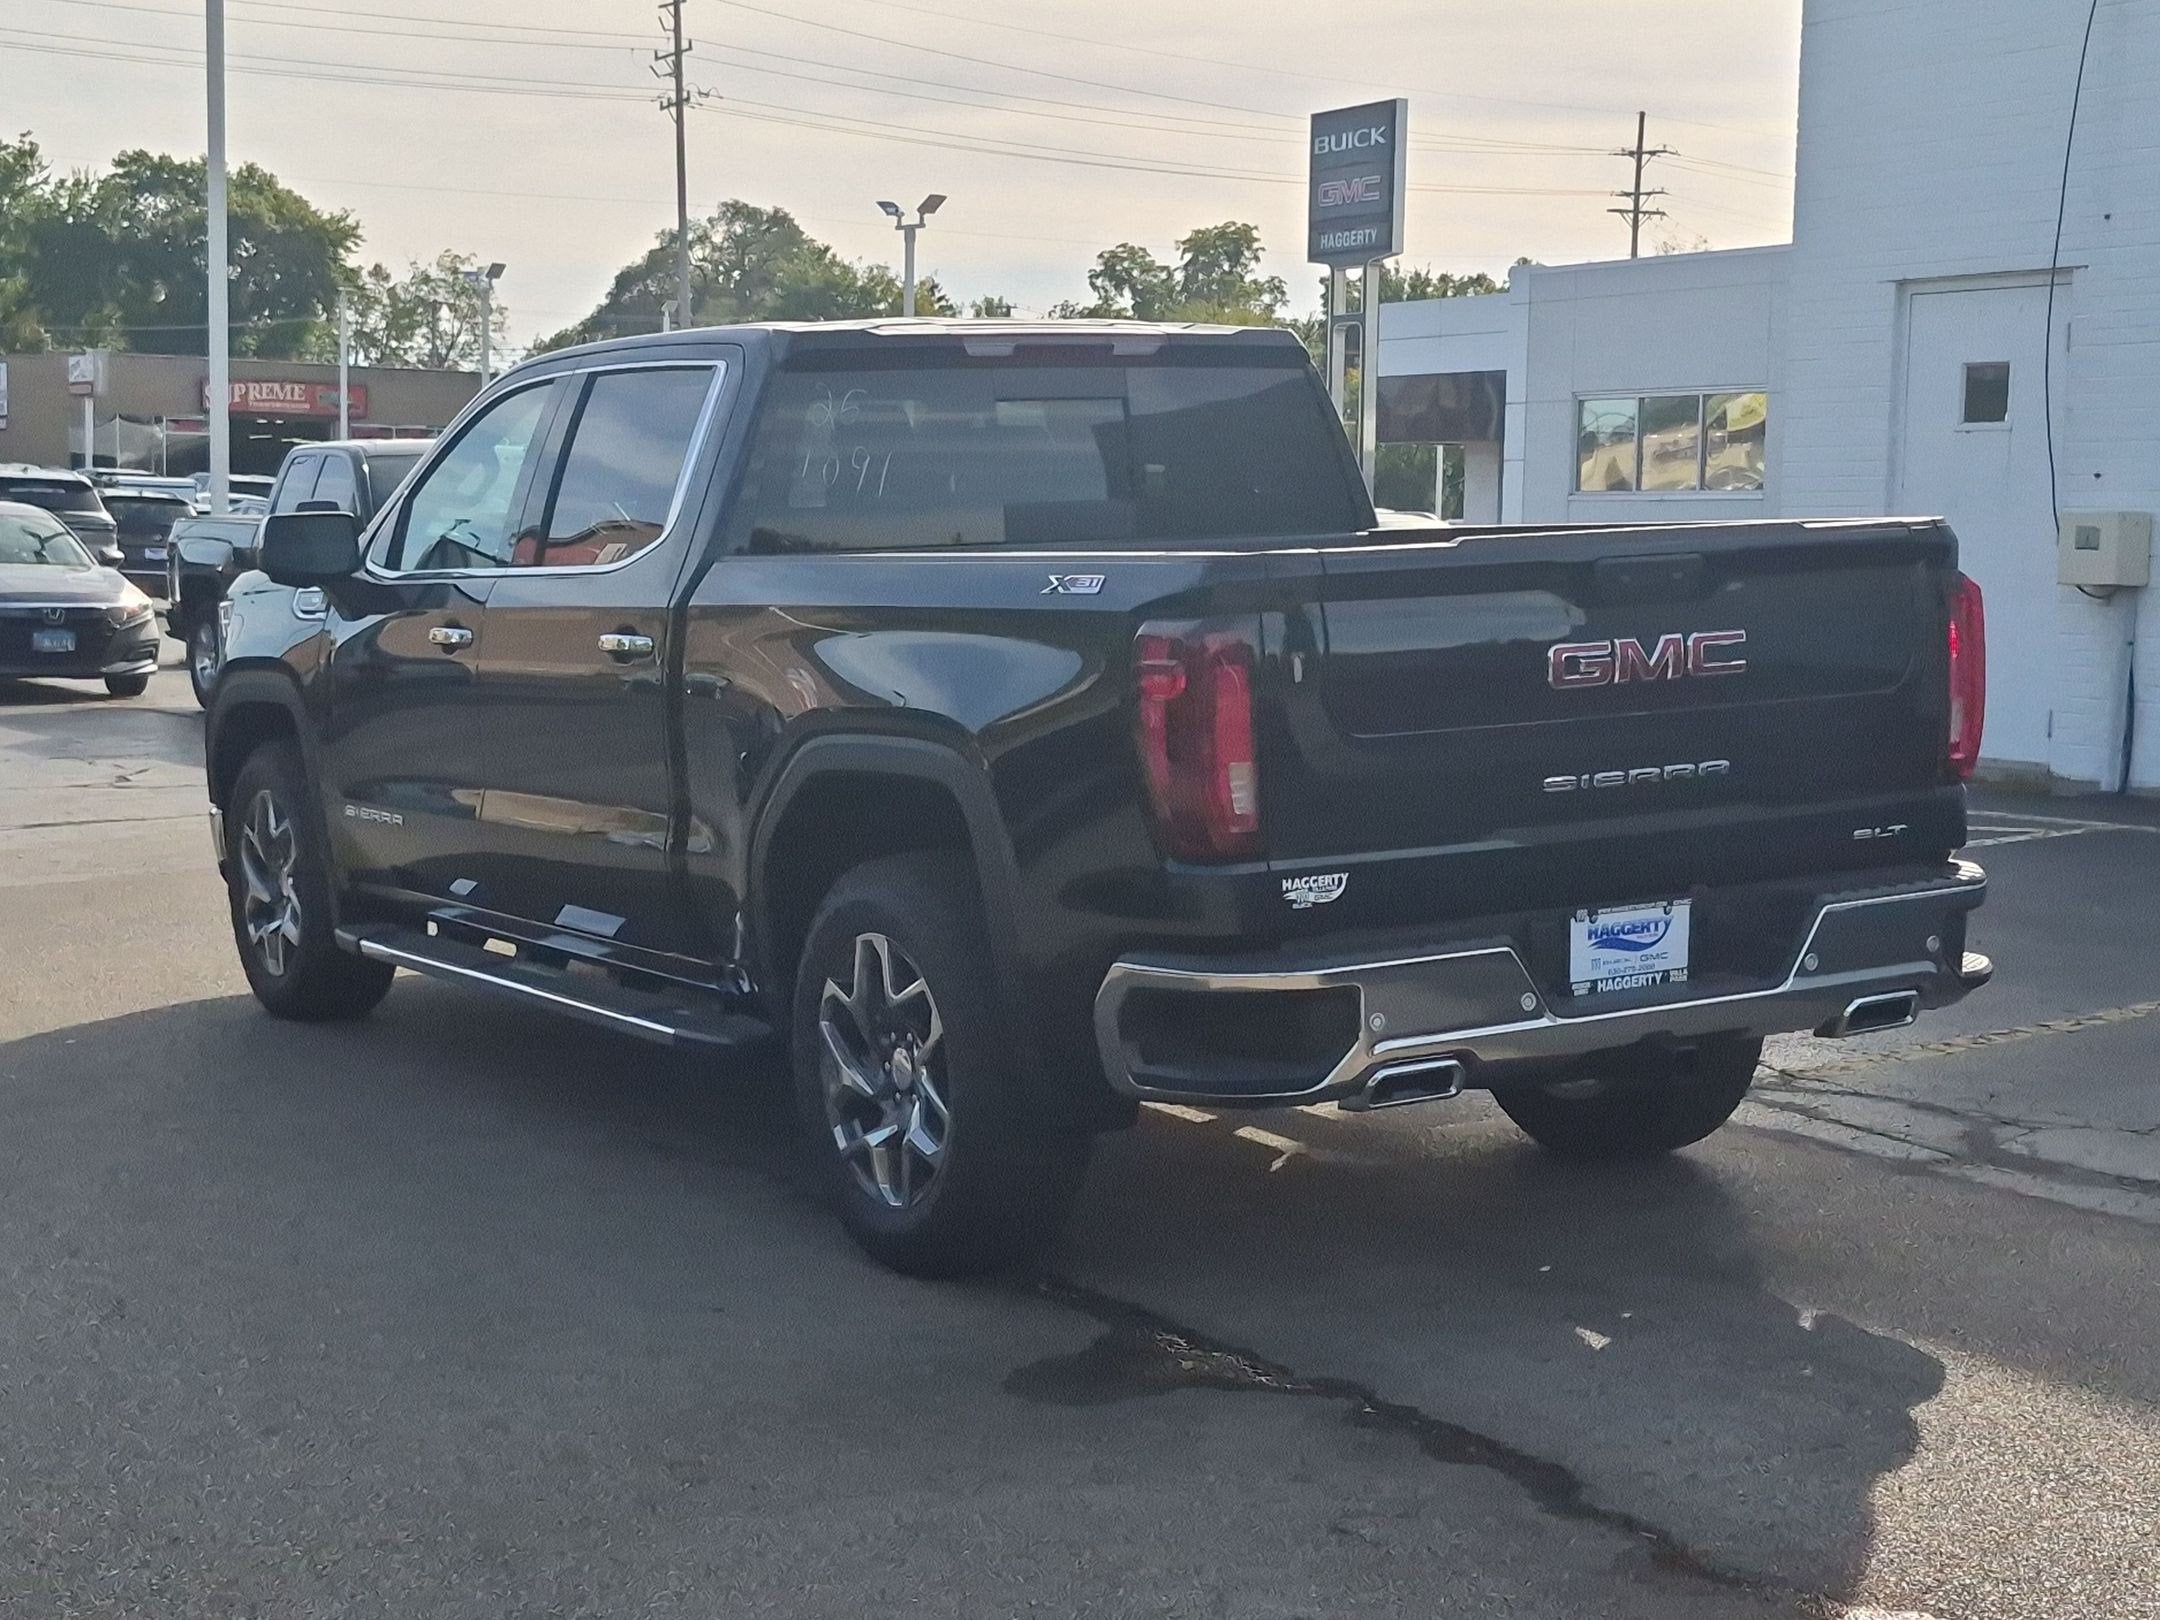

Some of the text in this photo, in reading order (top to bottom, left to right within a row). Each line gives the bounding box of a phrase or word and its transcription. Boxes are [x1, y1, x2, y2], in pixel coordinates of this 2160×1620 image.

[1314, 126, 1386, 154] BUICK
[1319, 175, 1381, 207] GMC
[1320, 228, 1377, 249] HAGGERTY
[204, 382, 305, 408] PREME
[802, 446, 893, 496] 1091
[1040, 574, 1105, 593] X31
[1548, 629, 1747, 689] GMC
[1543, 760, 1730, 792] SIERRA
[345, 804, 403, 826] SIERRA
[1853, 824, 1908, 839] SLT
[1282, 872, 1349, 891] HAGGERTY
[1588, 915, 1674, 940] HAGGERTY
[1597, 972, 1663, 993] HAGGERTY
